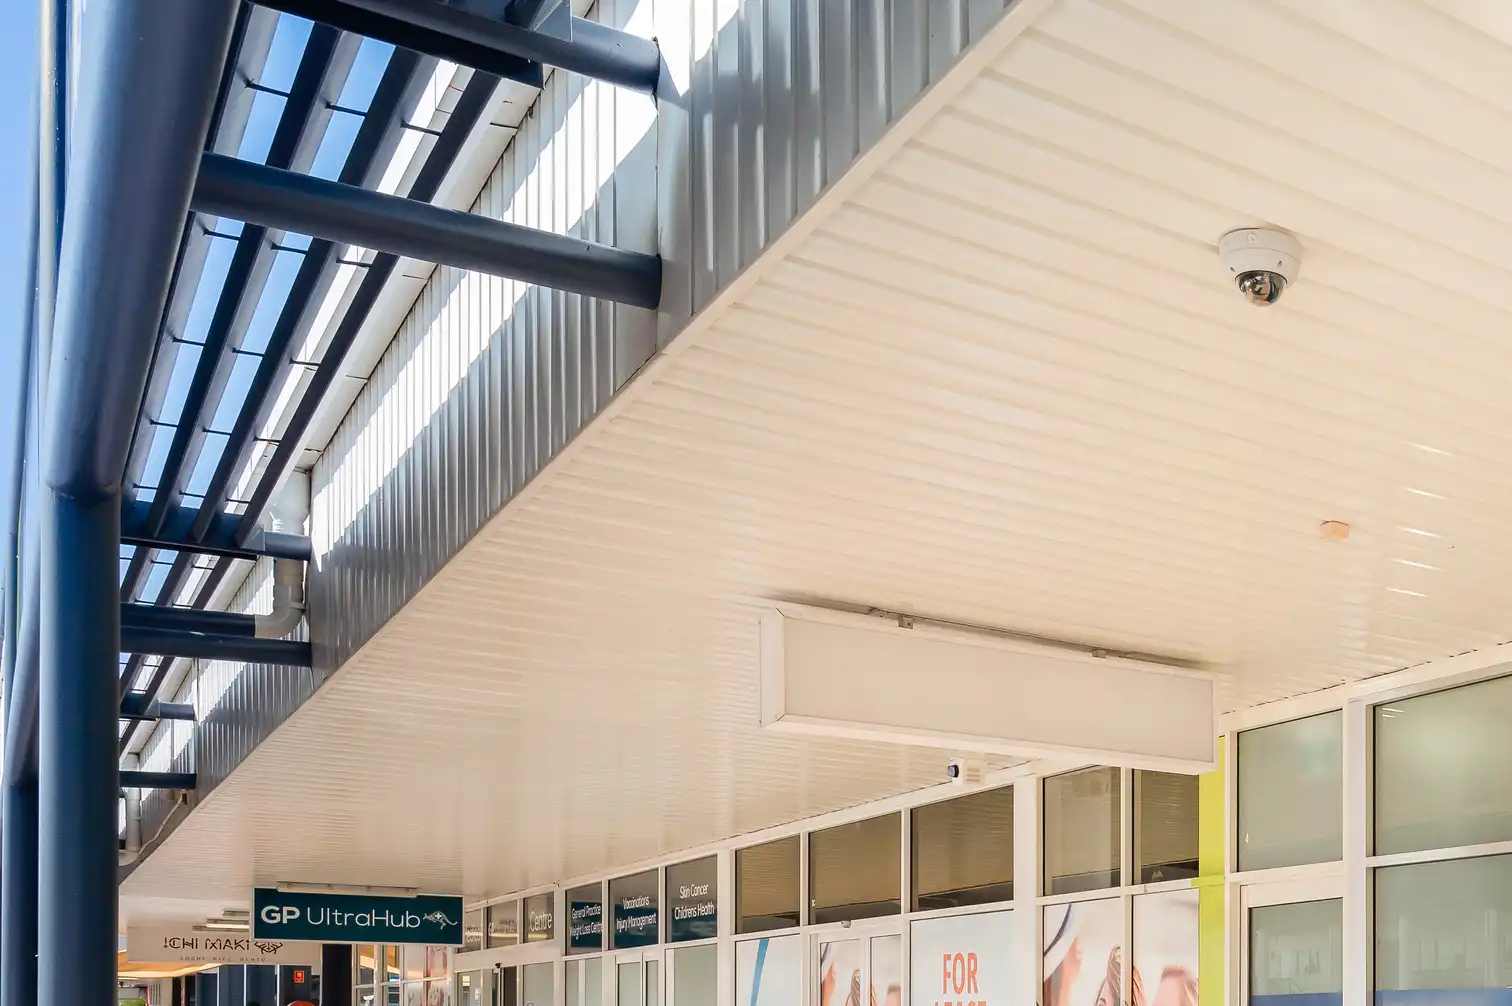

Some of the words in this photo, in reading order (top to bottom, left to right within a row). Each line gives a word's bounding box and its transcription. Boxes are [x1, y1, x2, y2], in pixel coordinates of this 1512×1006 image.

[680, 885, 691, 899] Skin
[691, 884, 709, 897] Cancer
[623, 895, 650, 910] Vaccinations
[675, 904, 697, 920] Childrens
[698, 901, 715, 917] Health
[261, 905, 300, 924] GP
[307, 907, 421, 928] UltraHub
[529, 911, 553, 932] Centre
[616, 917, 628, 932] Injury
[628, 913, 657, 931] Management
[942, 952, 979, 995] FOR
